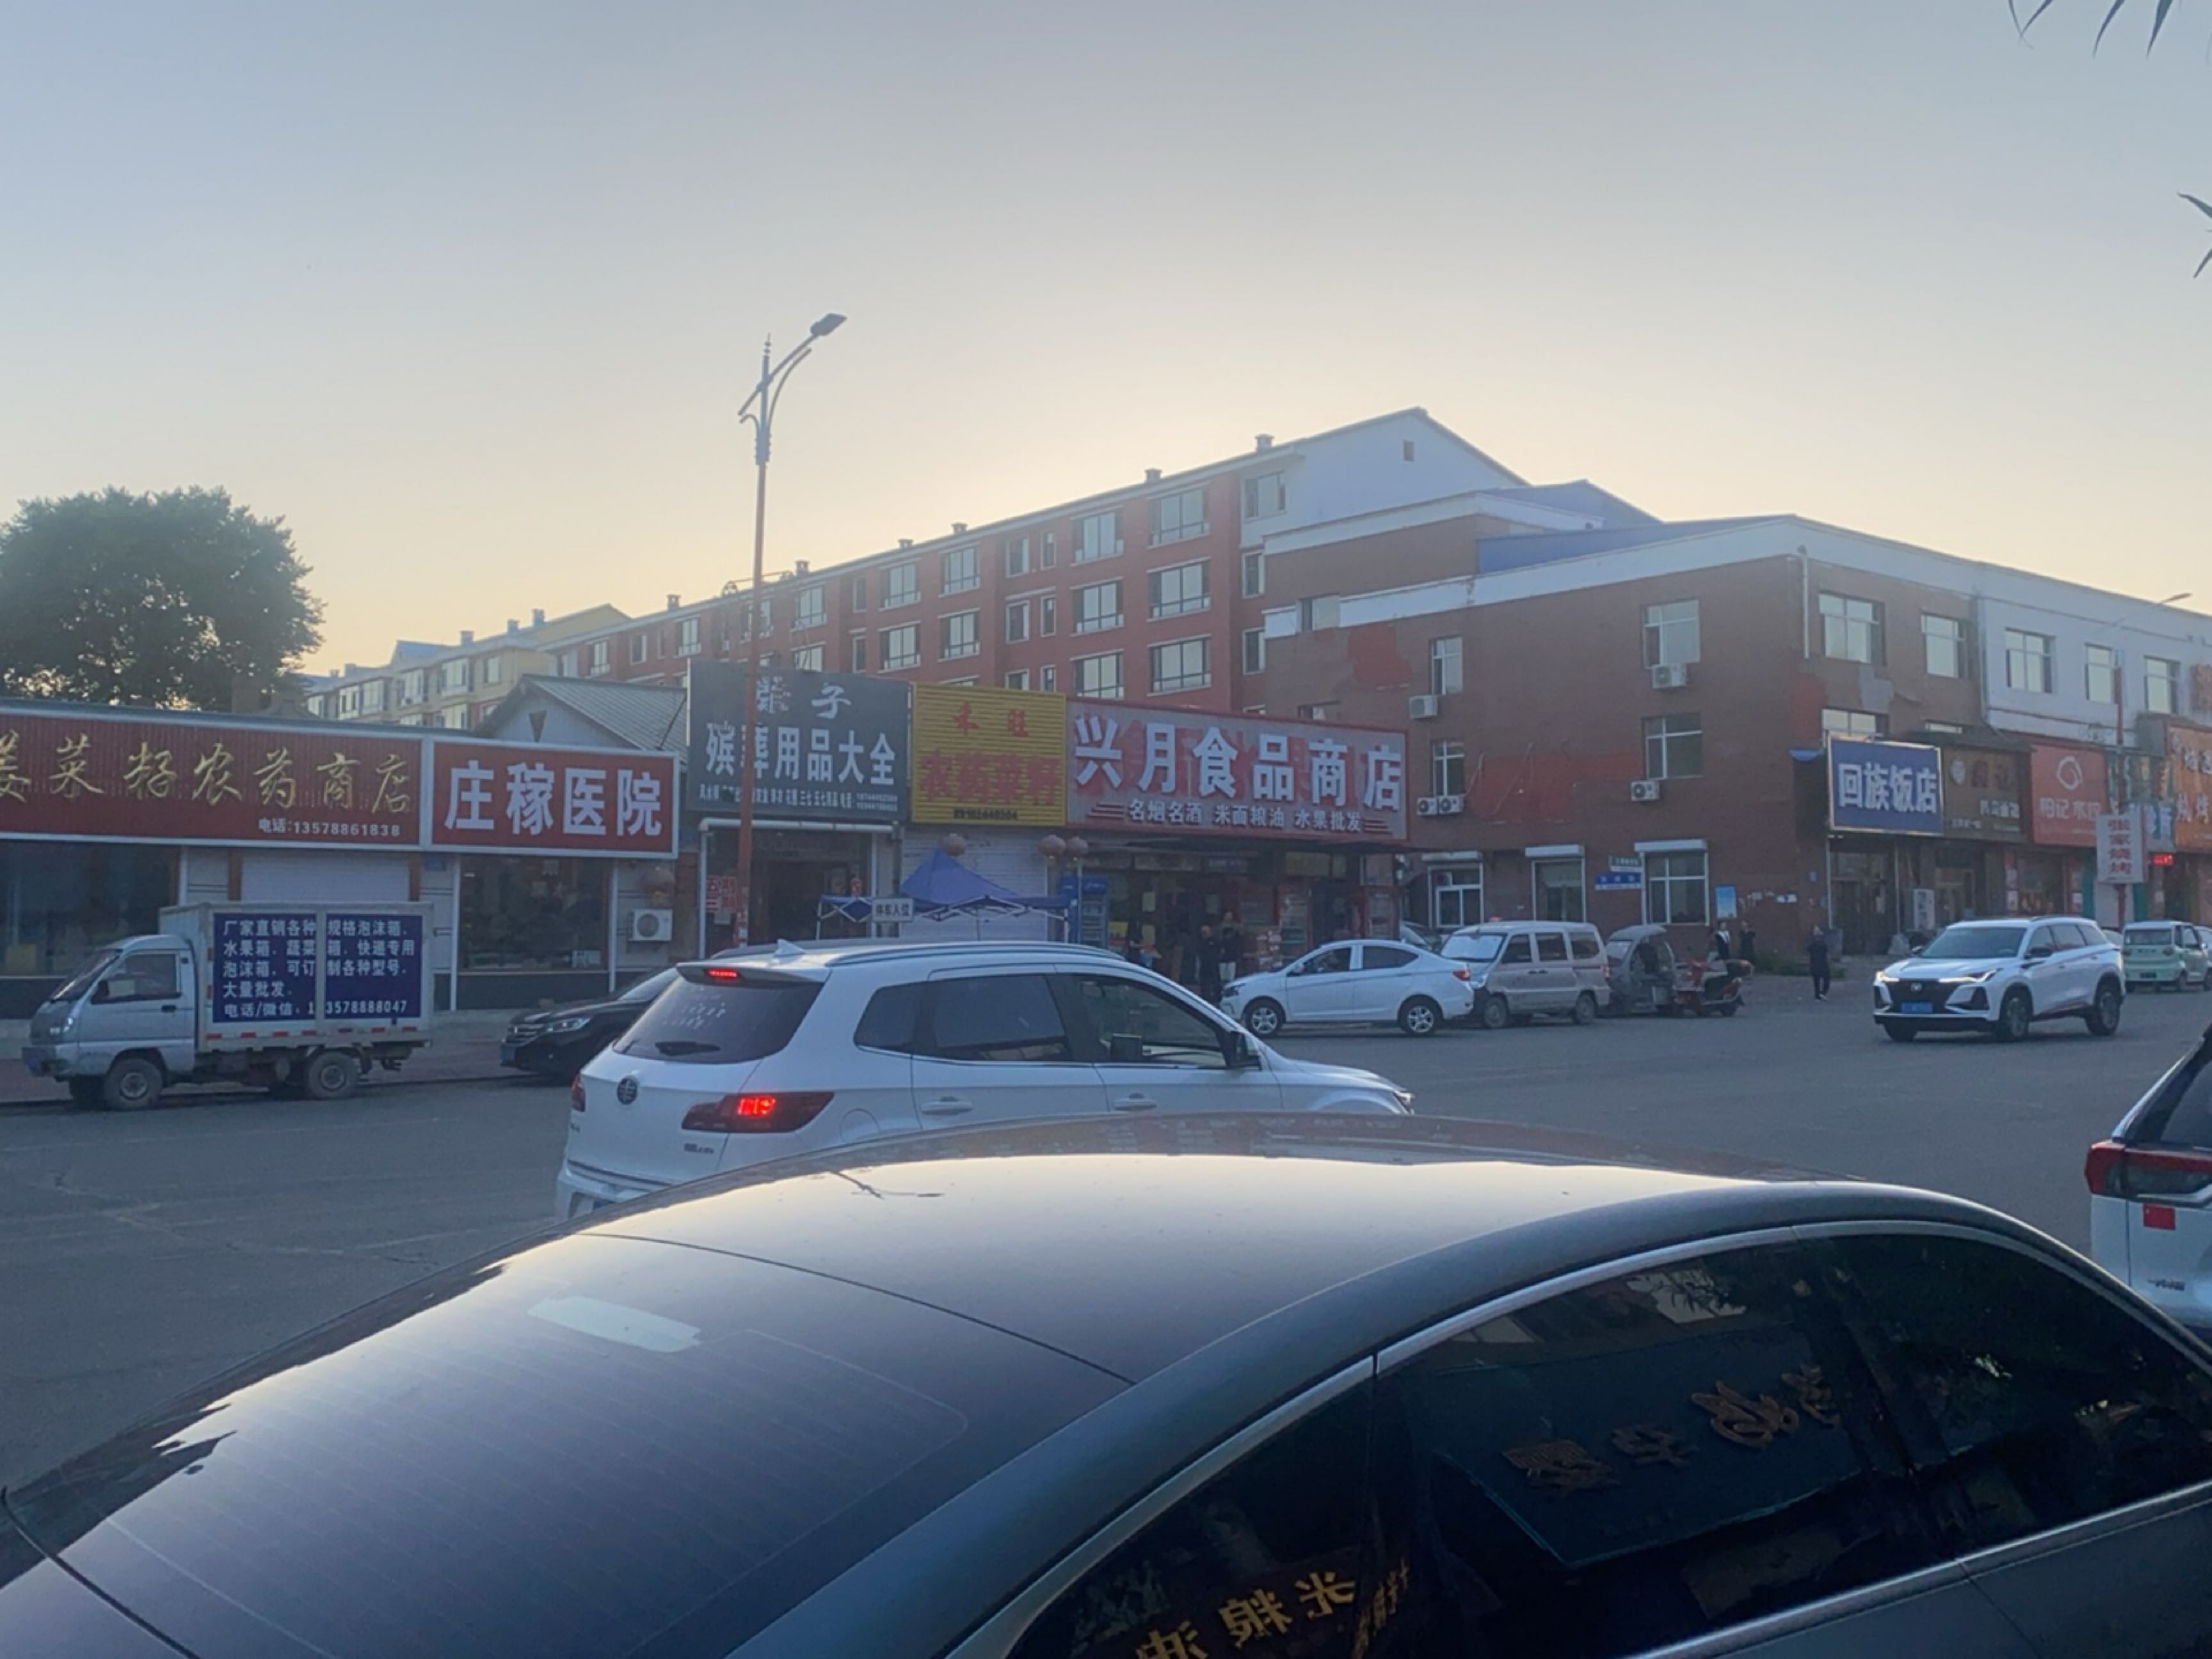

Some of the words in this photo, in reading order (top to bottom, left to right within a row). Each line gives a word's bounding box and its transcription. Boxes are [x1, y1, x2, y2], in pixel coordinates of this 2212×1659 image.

[1075, 716, 1402, 812] 兴月食品商店
[1838, 761, 1936, 813] 回族饭店
[444, 760, 662, 836] 庄稼医院
[1129, 798, 1202, 823] 名烟名酒
[1213, 803, 1285, 828] 米面粮油
[1294, 808, 1361, 832] 水果批发
